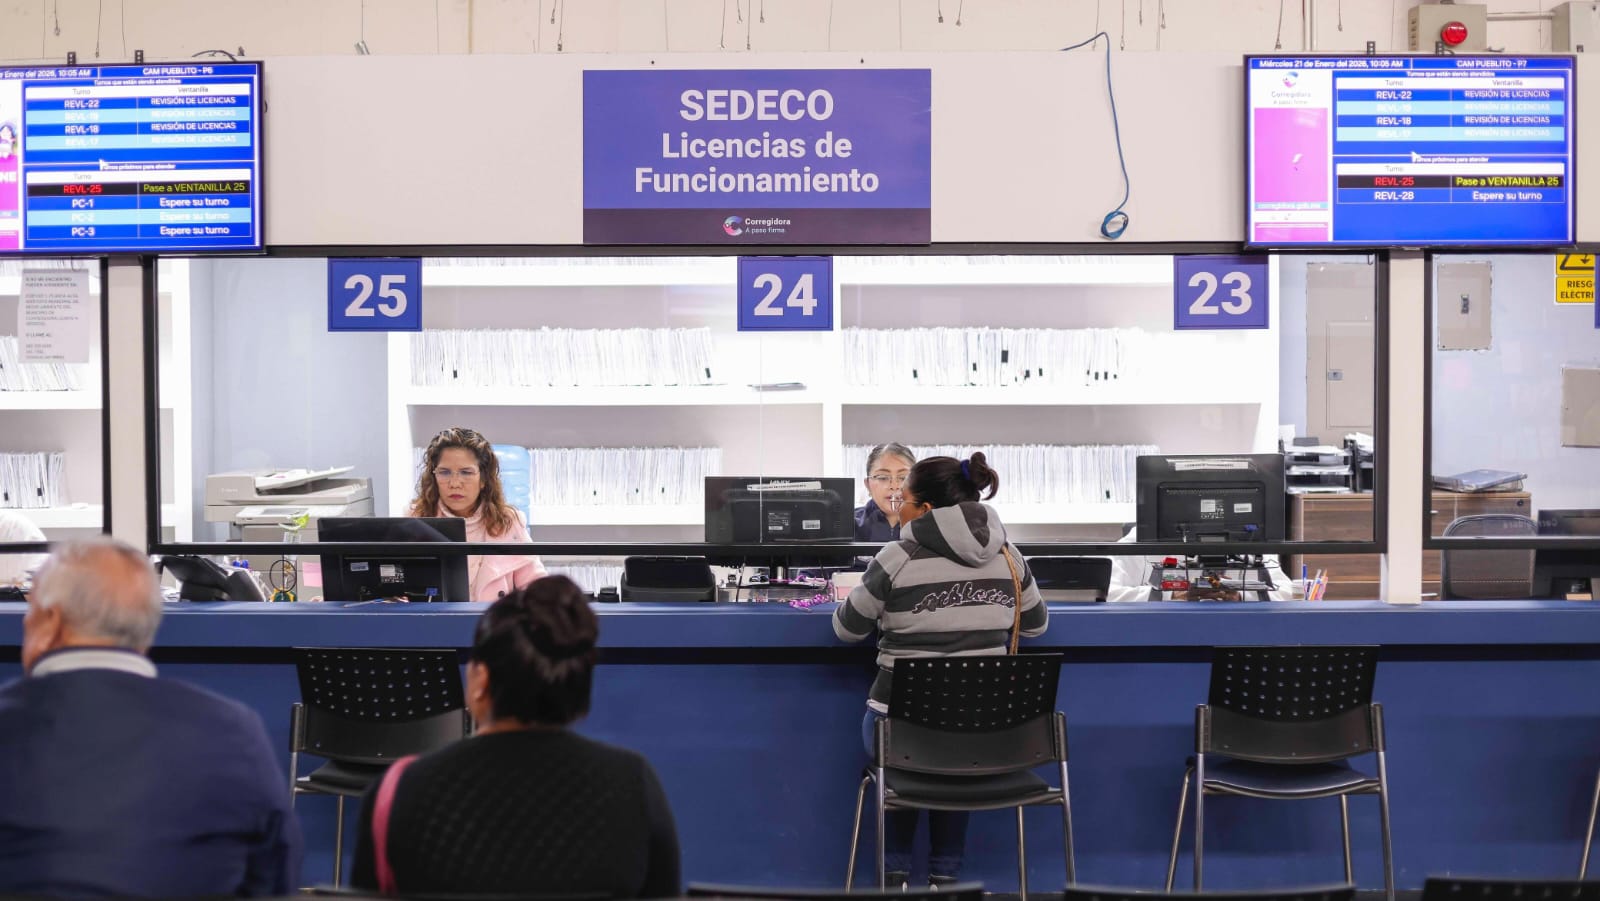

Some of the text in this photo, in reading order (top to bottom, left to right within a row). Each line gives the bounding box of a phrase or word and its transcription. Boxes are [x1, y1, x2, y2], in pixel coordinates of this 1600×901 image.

[1376, 91, 1412, 99] REVL-22
[64, 100, 100, 108] REVL-22
[151, 96, 184, 105] REVISIÓN
[680, 88, 834, 121] SEDECO
[1465, 115, 1498, 123] REVISIÓN
[64, 125, 99, 134] REVL-18
[151, 122, 184, 130] REVISIÓN
[662, 131, 852, 158] Licencias de
[635, 166, 880, 193] Funcionamiento
[1375, 177, 1414, 186] REVL-25
[1456, 177, 1478, 185] Pase
[1488, 177, 1545, 185] VENTANILLA
[1547, 177, 1559, 185] 25
[63, 184, 102, 194] REVL-25
[143, 184, 164, 192] Pase
[174, 183, 231, 192] VENTANILLA
[233, 183, 245, 191] 25
[1374, 191, 1414, 200] REVL-28
[1472, 191, 1504, 202] Espere
[1518, 191, 1543, 200] turno
[72, 199, 94, 208] PC-1
[160, 198, 191, 208] Espere
[205, 198, 229, 206] turno
[745, 218, 791, 226] Corregidora
[72, 227, 95, 236] PC-3
[160, 226, 191, 237] Espere
[344, 274, 407, 317] 25
[753, 273, 817, 315] 24
[1188, 272, 1252, 315] 23
